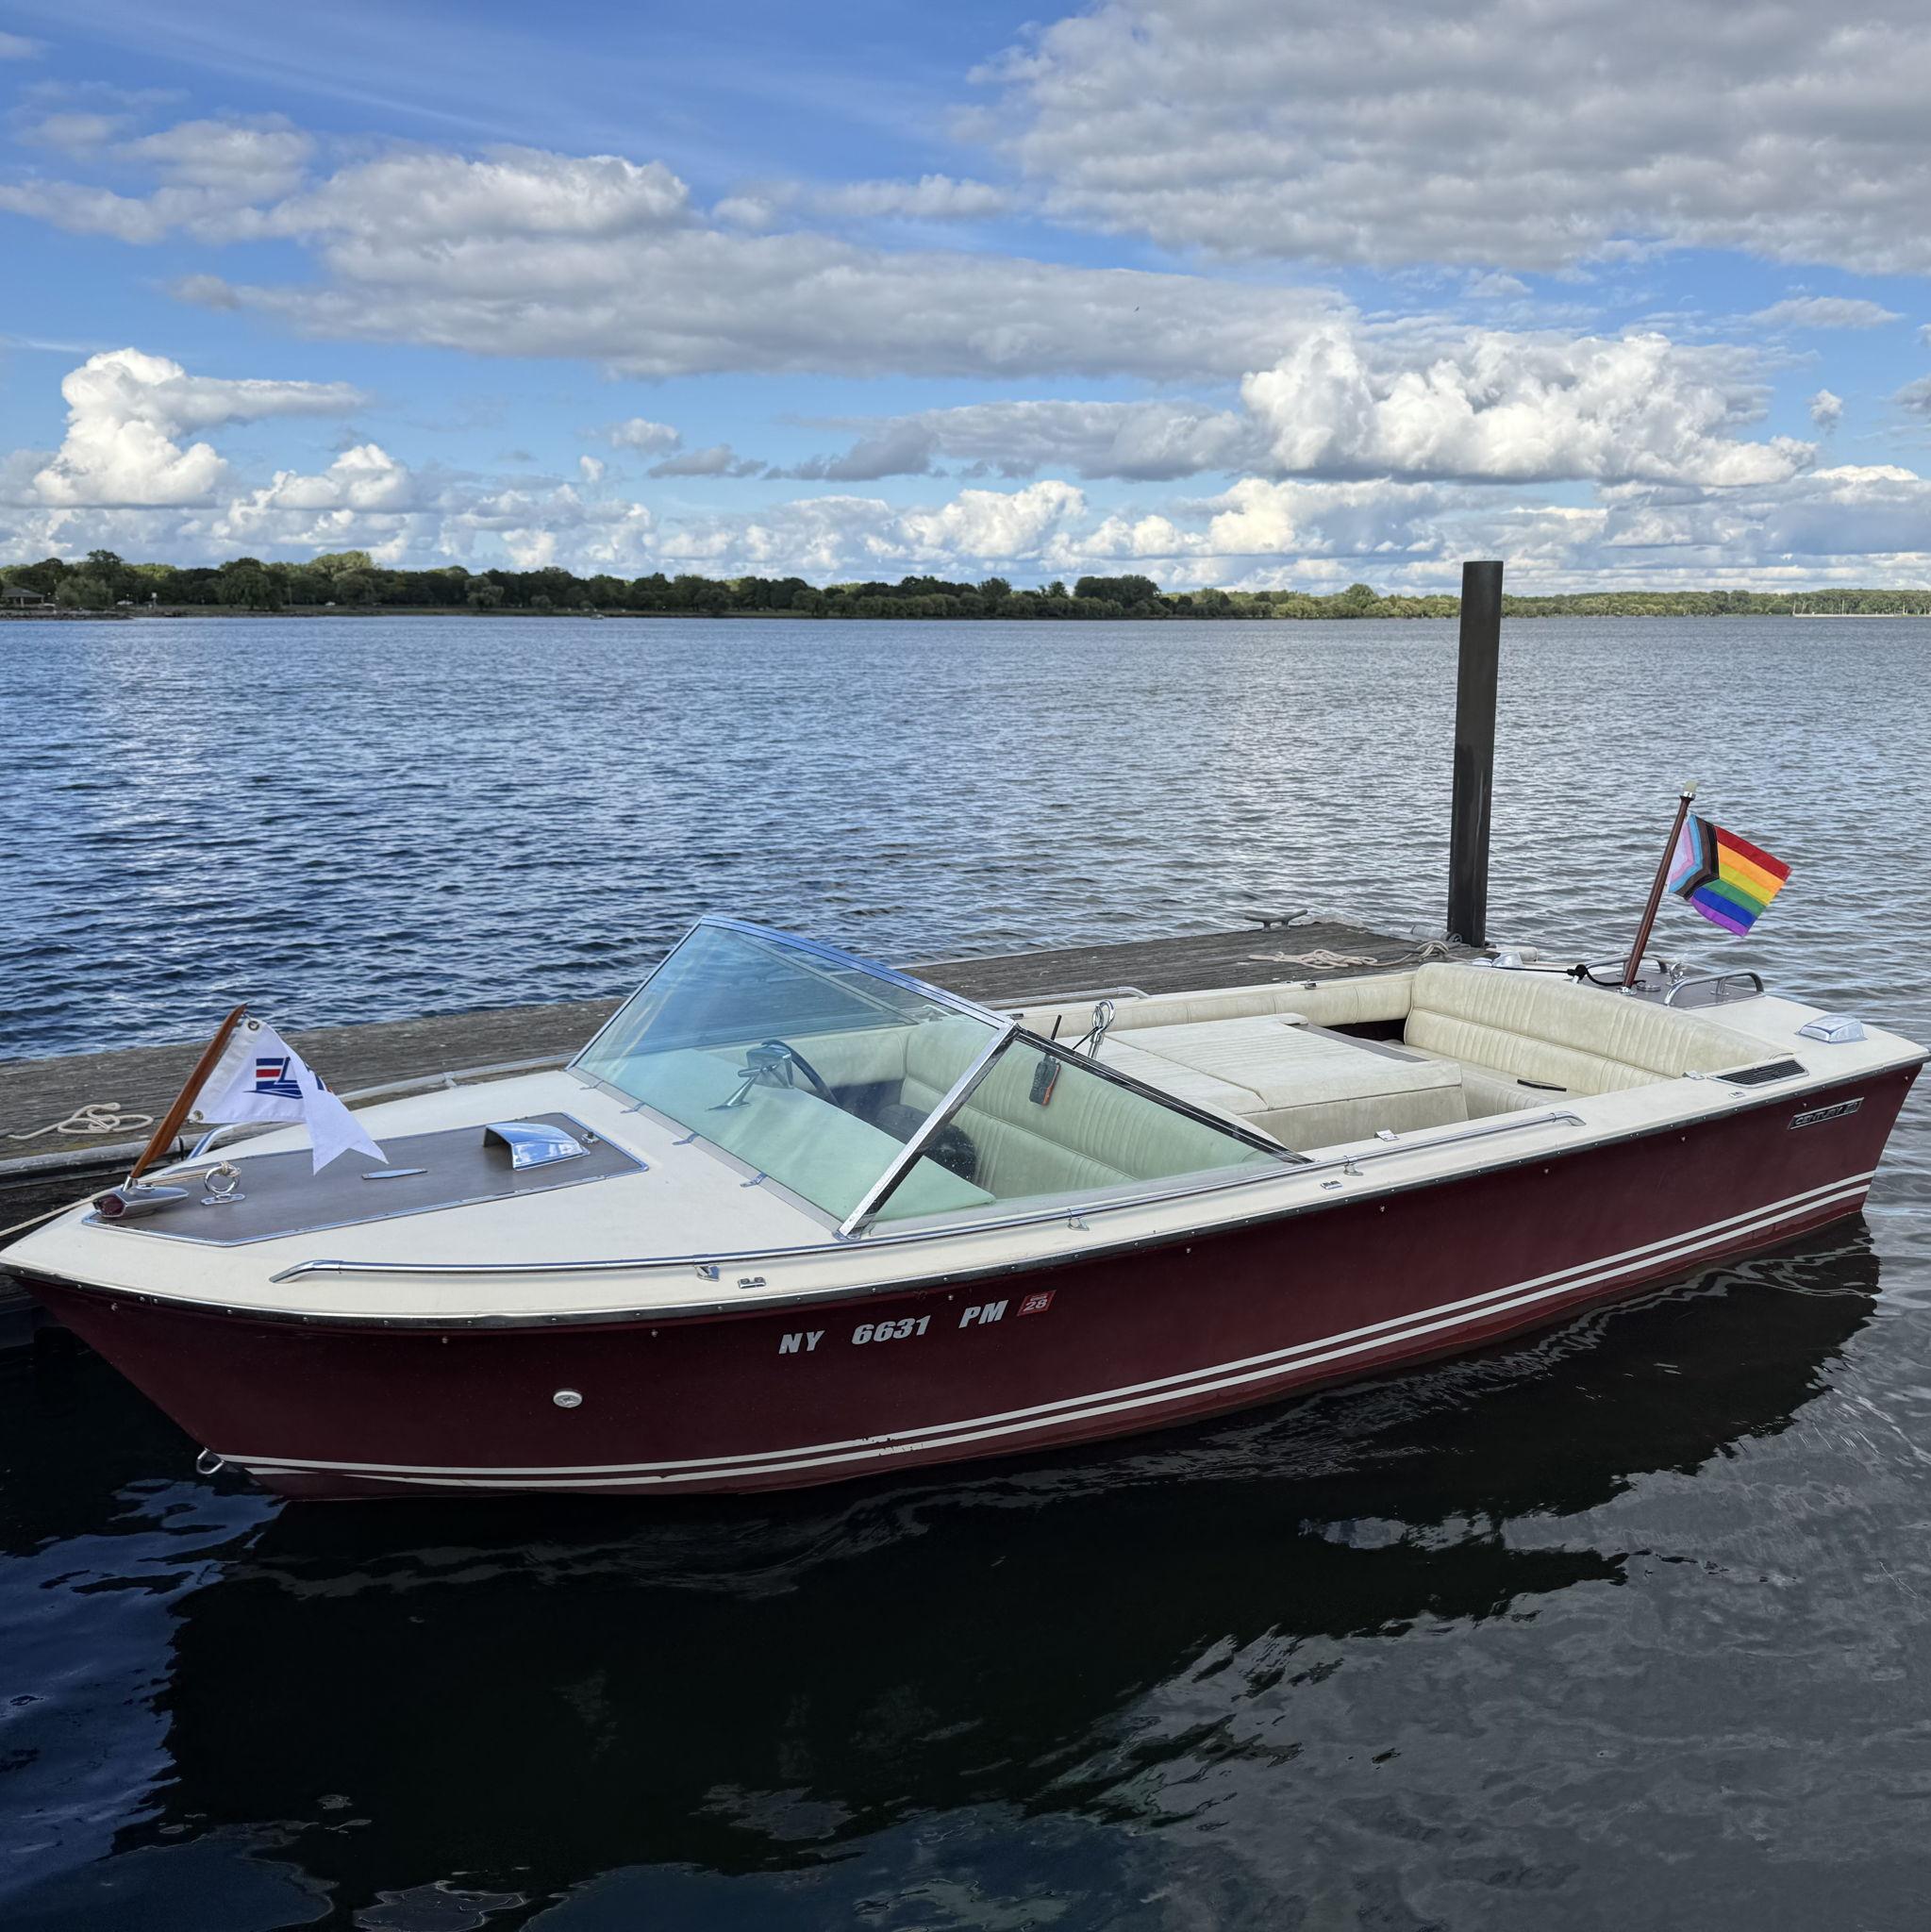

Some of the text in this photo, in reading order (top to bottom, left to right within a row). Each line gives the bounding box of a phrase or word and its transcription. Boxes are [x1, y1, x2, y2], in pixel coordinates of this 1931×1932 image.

[1794, 1107, 1843, 1125] CENTURY
[778, 1300, 1009, 1355] NY 6631 PM
